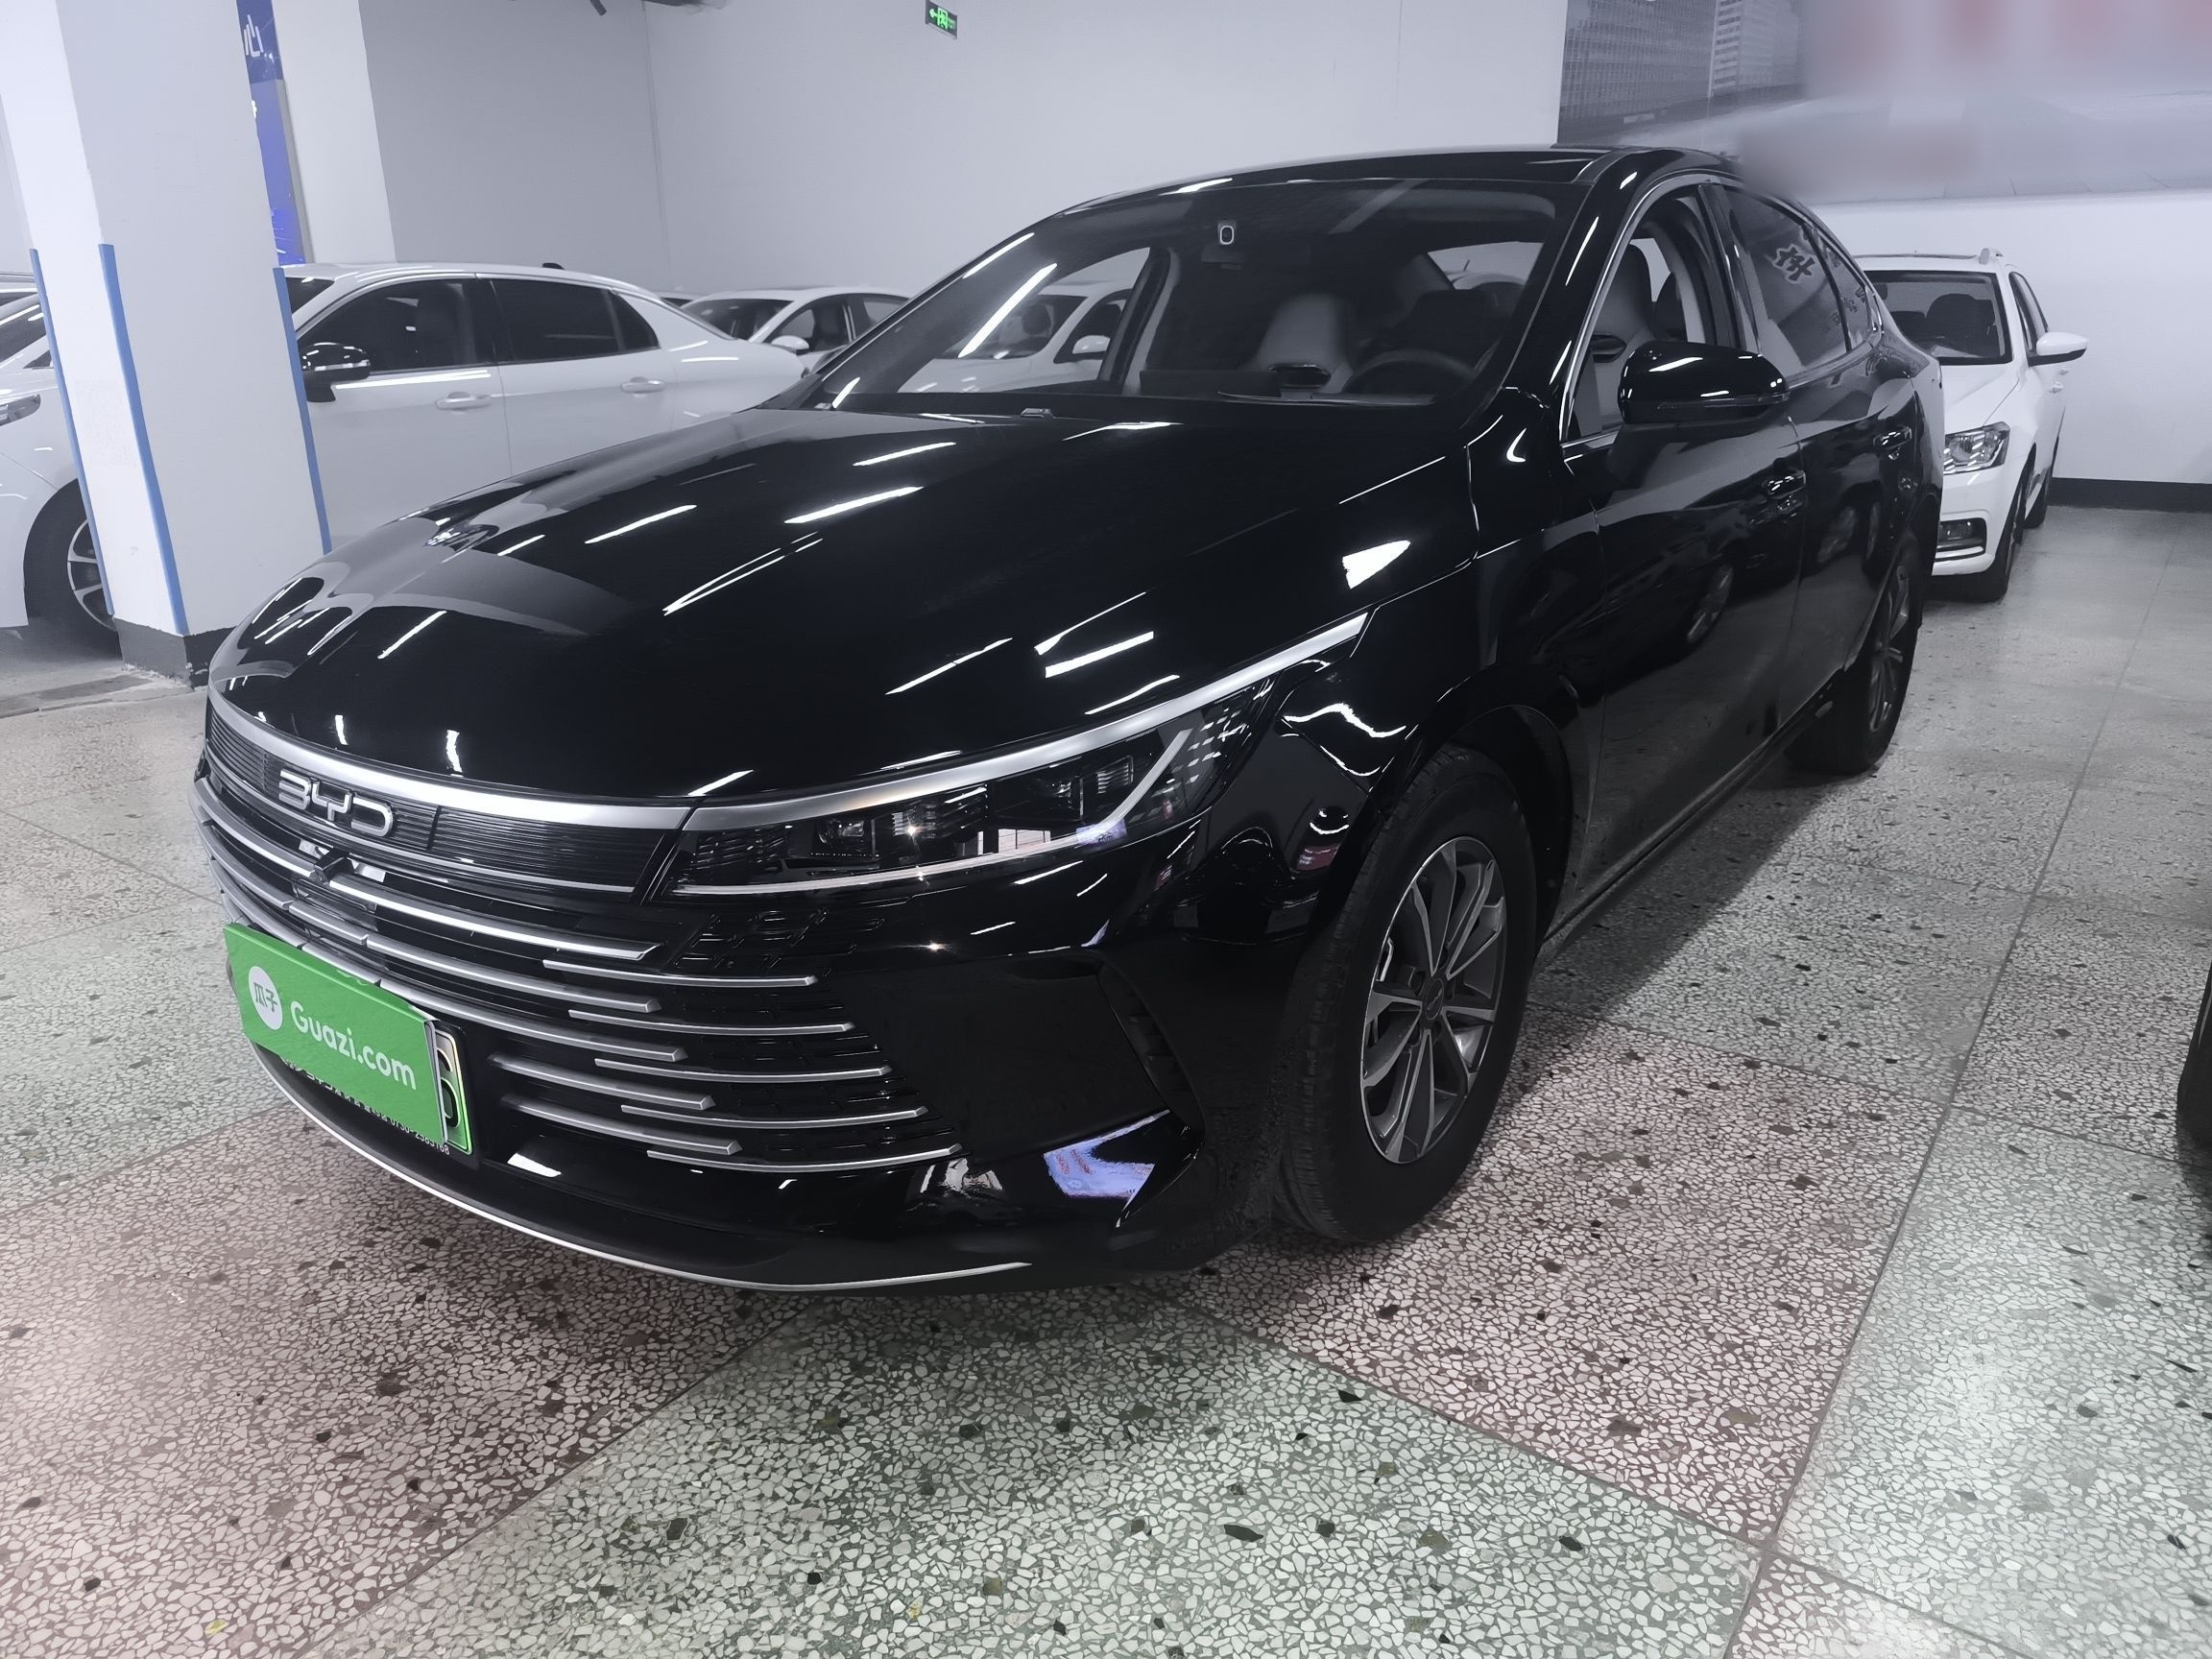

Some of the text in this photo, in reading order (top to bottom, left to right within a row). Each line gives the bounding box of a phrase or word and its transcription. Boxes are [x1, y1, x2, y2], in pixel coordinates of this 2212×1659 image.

[278, 769, 393, 837] BYD
[252, 981, 278, 1014] 瓜子
[290, 1000, 417, 1092] Guazi.com
